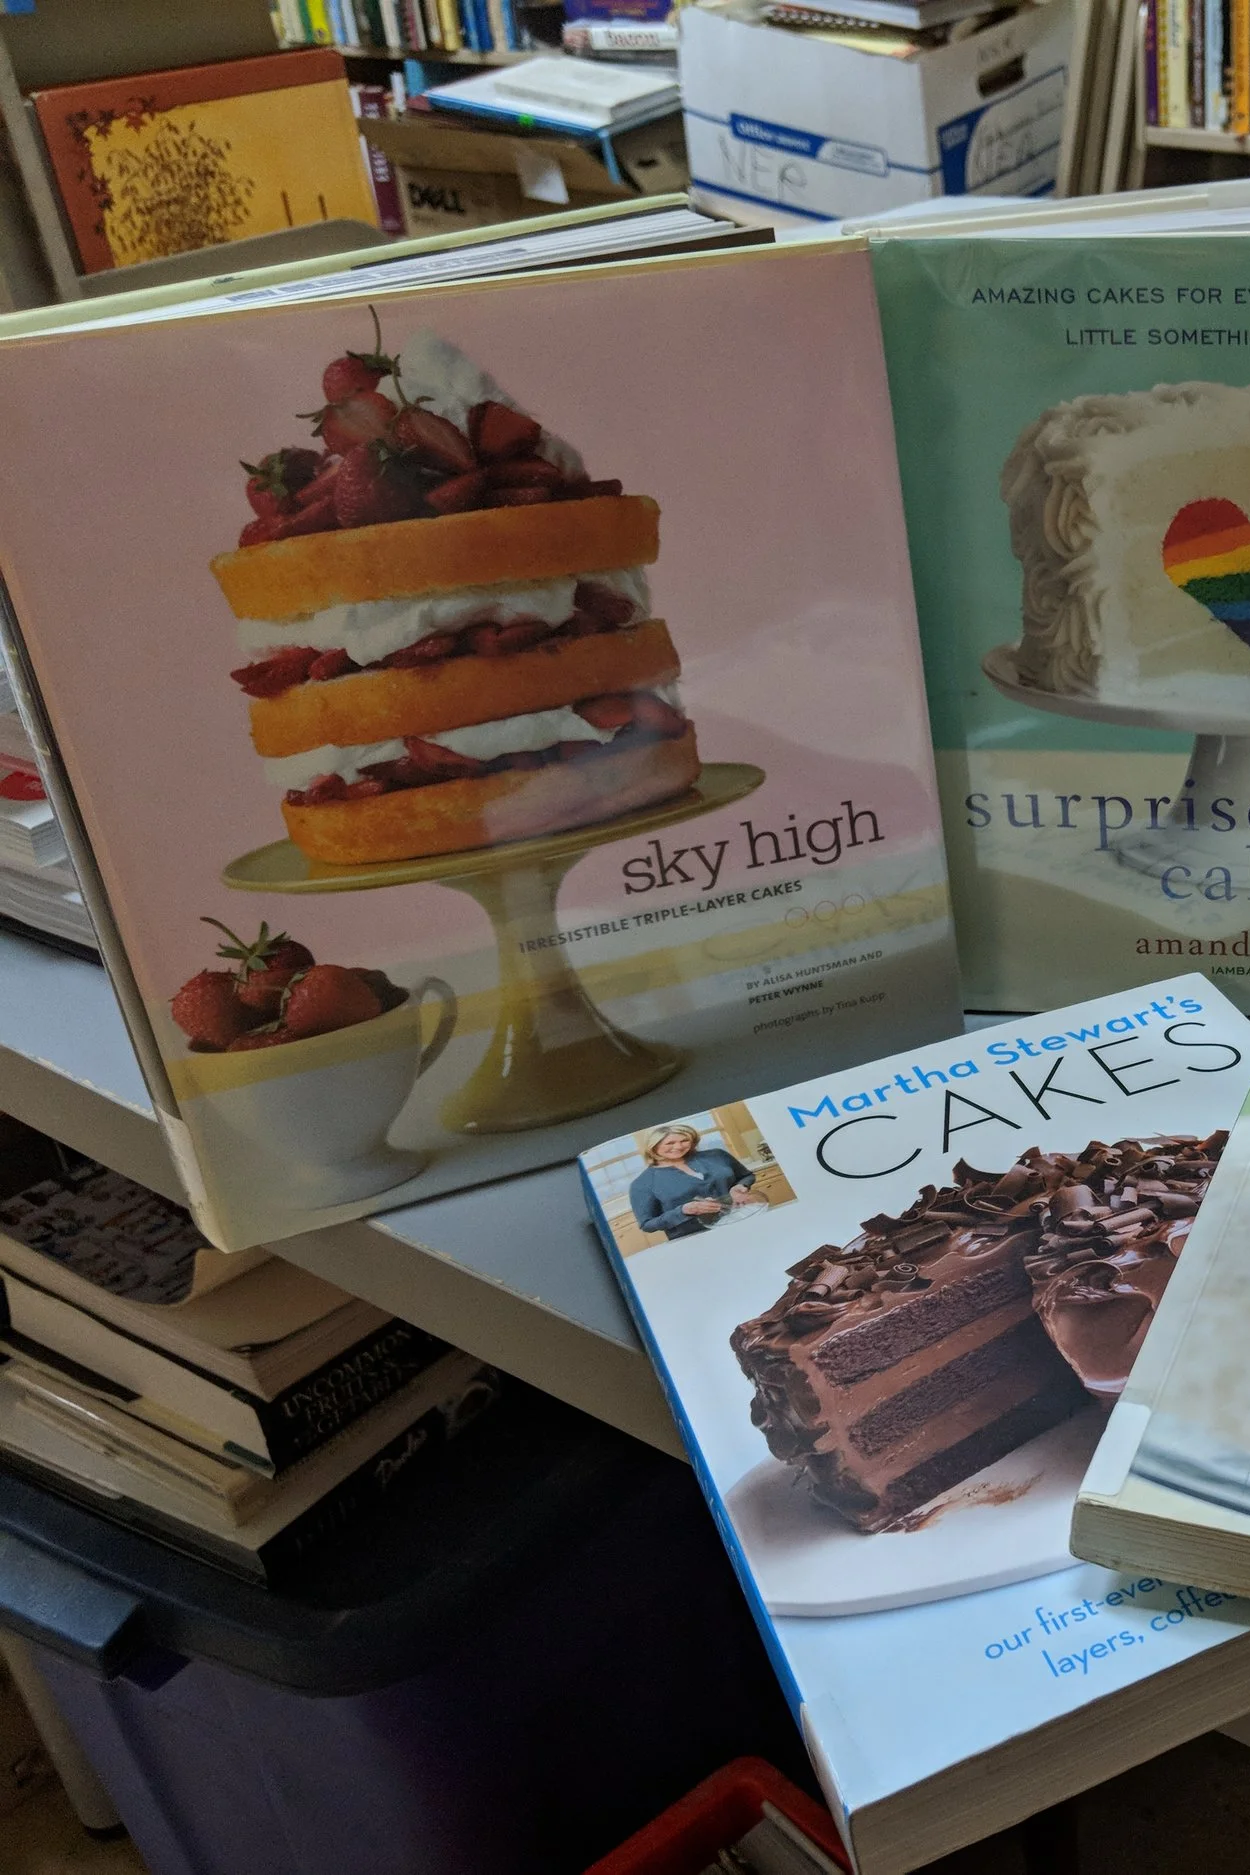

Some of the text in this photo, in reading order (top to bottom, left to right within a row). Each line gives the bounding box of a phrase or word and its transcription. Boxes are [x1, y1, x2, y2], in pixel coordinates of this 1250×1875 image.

[971, 287, 1076, 305] AMAZING
[1087, 287, 1165, 304] CAKES
[1176, 287, 1224, 304] FOR
[1065, 329, 1137, 346] LITTLE
[622, 801, 885, 896] sky high
[518, 879, 804, 955] IRRESISTIBLE TRIPLE-LAYER CAKES
[746, 949, 884, 991] BY ALISA HUNTSMAN AND
[748, 979, 824, 1006] PETER WYNNE
[752, 1008, 821, 1035] photographs
[822, 1004, 834, 1016] by
[786, 994, 1204, 1129] Martha Stewart's
[816, 1021, 1242, 1180] CAKES
[984, 1626, 1033, 1660] our
[1041, 1629, 1145, 1678] layers,
